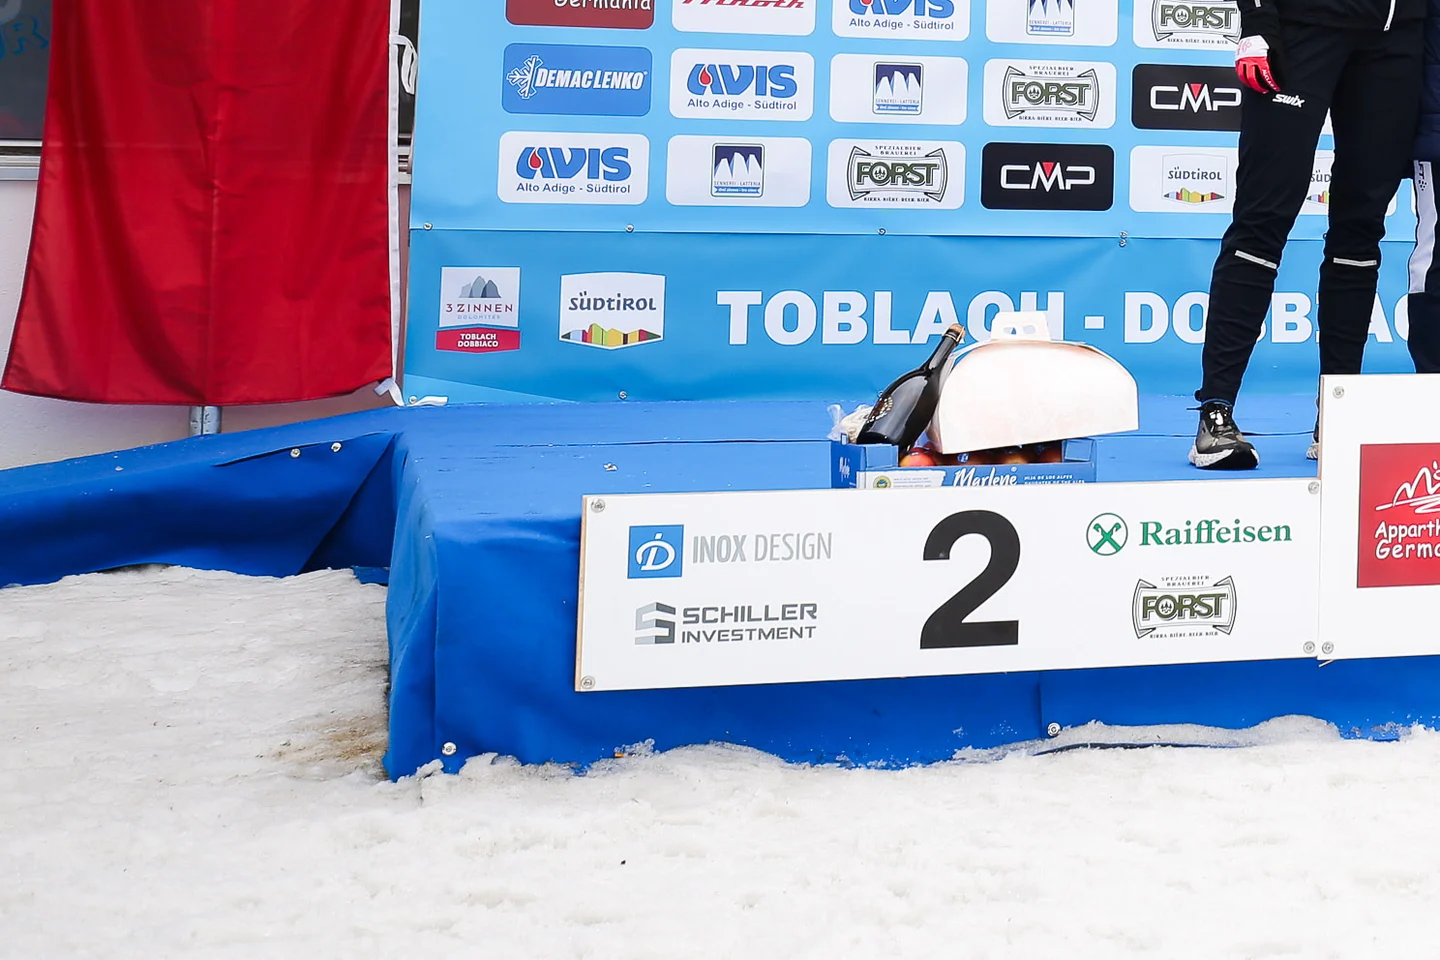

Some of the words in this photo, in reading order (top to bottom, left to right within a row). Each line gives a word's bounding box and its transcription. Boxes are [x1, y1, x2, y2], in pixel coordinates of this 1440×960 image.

[849, 17, 871, 28] Alto
[873, 18, 903, 30] Adige
[913, 19, 954, 31] Südtirol
[1160, 4, 1237, 29] FORST
[687, 63, 798, 99] AVIS
[687, 98, 710, 109] Alto
[712, 99, 744, 111] Adige
[754, 99, 797, 111] Südtirol
[1011, 81, 1091, 106] FORST
[1149, 82, 1242, 113] CMP
[1272, 94, 1305, 108] swix
[516, 146, 631, 182] AVIS
[856, 162, 939, 186] FORST
[516, 182, 540, 193] Alto
[542, 183, 575, 195] Adige
[586, 183, 631, 194] Südtirol
[1000, 161, 1095, 192] CMP
[445, 303, 454, 313] 3
[457, 303, 513, 313] ZINNEN
[457, 340, 499, 348] DOBBIACO
[953, 467, 1018, 488] Marlene
[1139, 518, 1292, 547] Raiffeisen
[692, 533, 747, 564] INOX
[753, 531, 833, 561] DESIGN
[920, 510, 1022, 650] 2
[681, 602, 818, 626] SCHILLER
[1142, 593, 1228, 621] FORST
[680, 622, 818, 645] INVESTMENT
